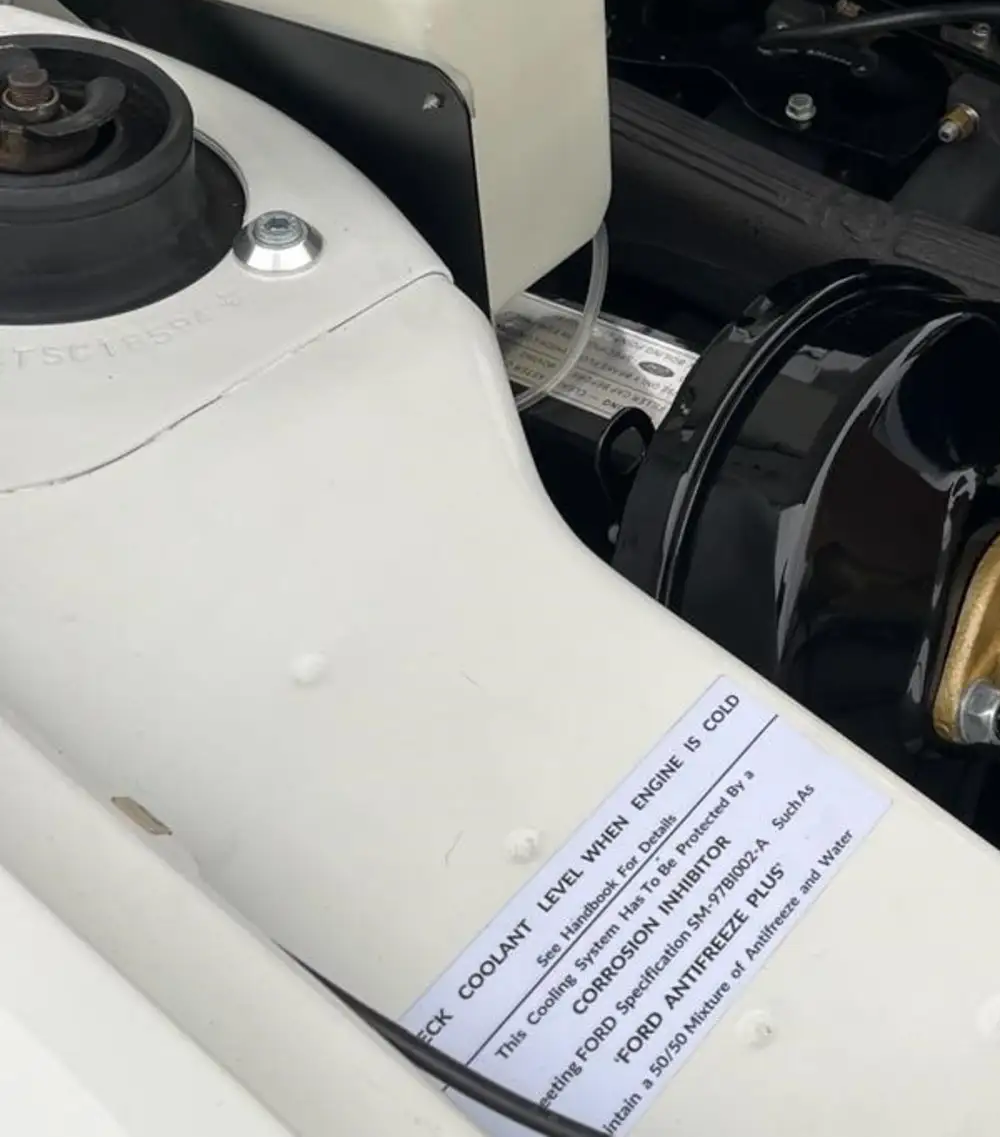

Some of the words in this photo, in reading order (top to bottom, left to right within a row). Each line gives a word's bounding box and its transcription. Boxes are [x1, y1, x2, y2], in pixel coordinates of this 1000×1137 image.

[414, 1009, 454, 1047] ECK
[457, 918, 532, 1000] COOLANT
[536, 868, 584, 913] LEVEL
[580, 814, 630, 863] WHEN
[630, 755, 683, 811] ENGINE
[683, 736, 701, 753] IS
[702, 694, 740, 732] COLD
[493, 1029, 528, 1060] This
[526, 974, 578, 1025] Cooling
[574, 924, 620, 971] System
[617, 894, 646, 922] Has
[638, 876, 662, 894] To
[656, 857, 679, 878] Be
[675, 796, 730, 856] Protected
[725, 779, 746, 799] By
[535, 942, 563, 969] See
[559, 880, 619, 941] Handbook
[615, 855, 639, 879] For
[637, 815, 677, 854] Details
[572, 916, 661, 1015] CORROSION
[657, 835, 731, 916] INHIBITOR
[664, 908, 749, 1010] ANTIFREEZE
[538, 1062, 583, 1111] eeting
[575, 1015, 617, 1062] FORD
[615, 930, 692, 1016] Specification
[603, 1093, 642, 1137] intain
[649, 1032, 688, 1078] 50/50
[683, 982, 731, 1035] Mixture
[730, 959, 746, 980] of
[745, 897, 800, 961] Antifreeze
[799, 867, 822, 895] and
[816, 829, 854, 868] Water
